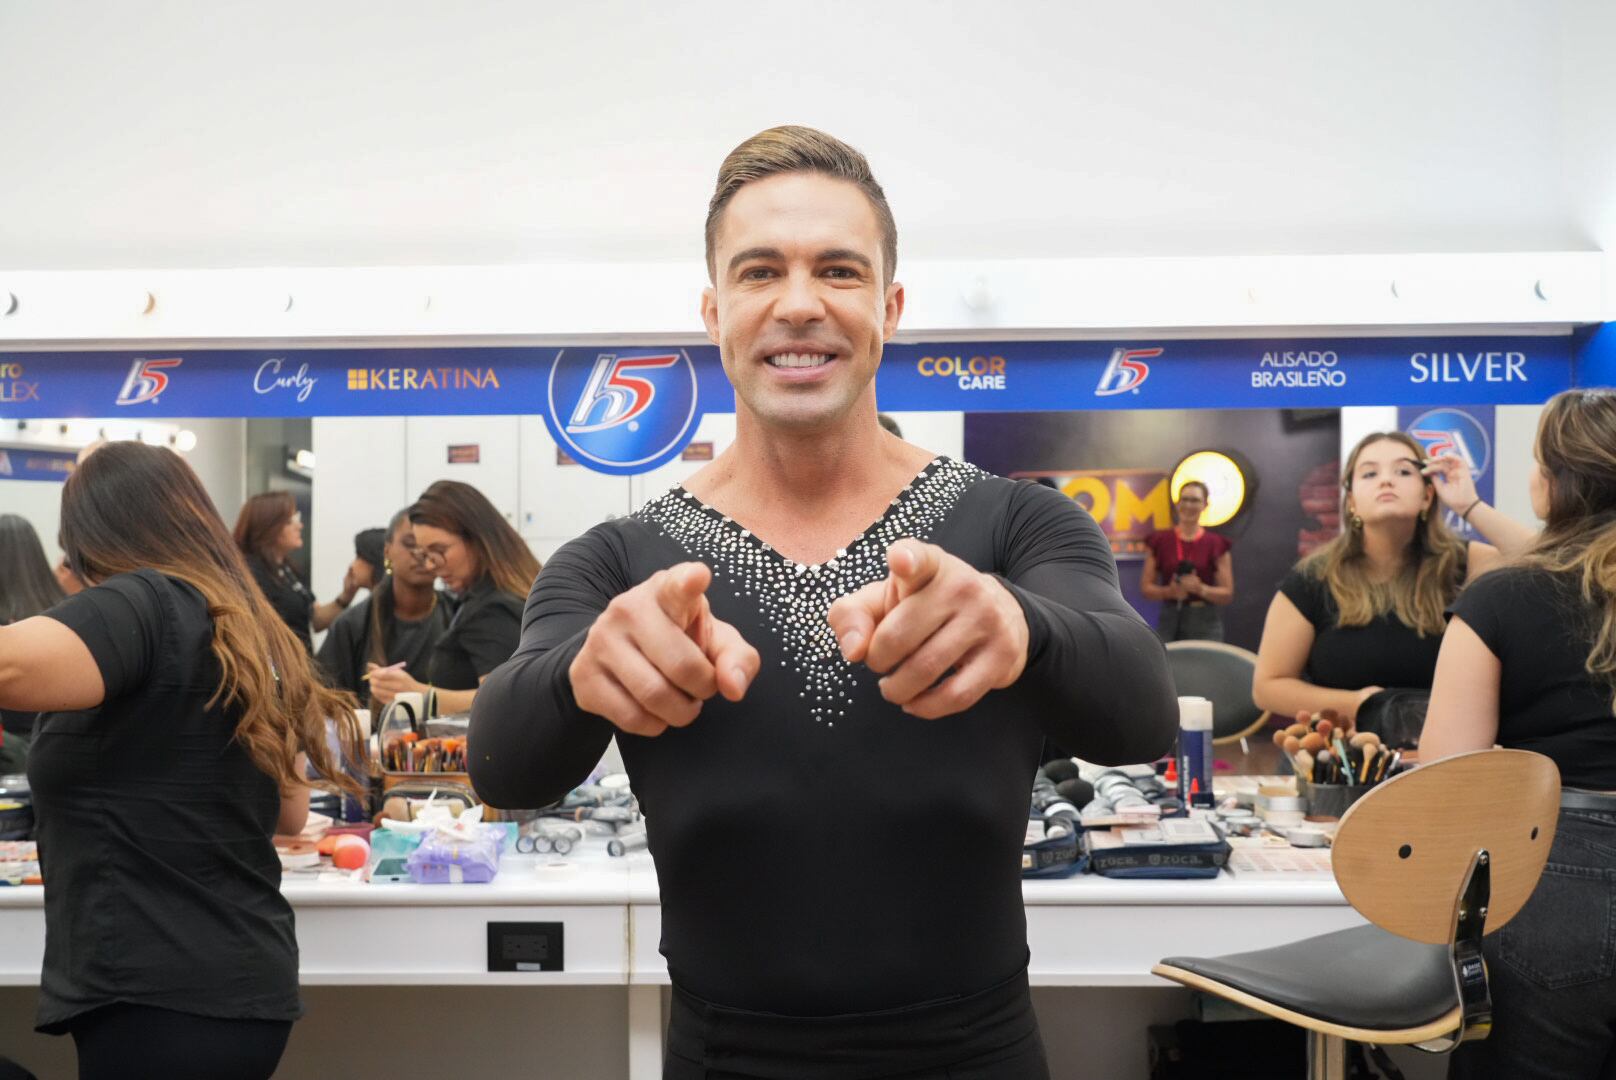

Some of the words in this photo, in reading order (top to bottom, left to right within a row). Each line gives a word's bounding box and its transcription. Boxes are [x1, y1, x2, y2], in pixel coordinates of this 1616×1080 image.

[917, 356, 1006, 377] COLOR
[1259, 350, 1338, 368] ALISADO
[1409, 352, 1528, 383] SILVER
[253, 358, 318, 402] Curly
[370, 367, 500, 390] KERATINA
[958, 375, 1006, 391] CARE
[1251, 368, 1346, 387] BRASILEÑO
